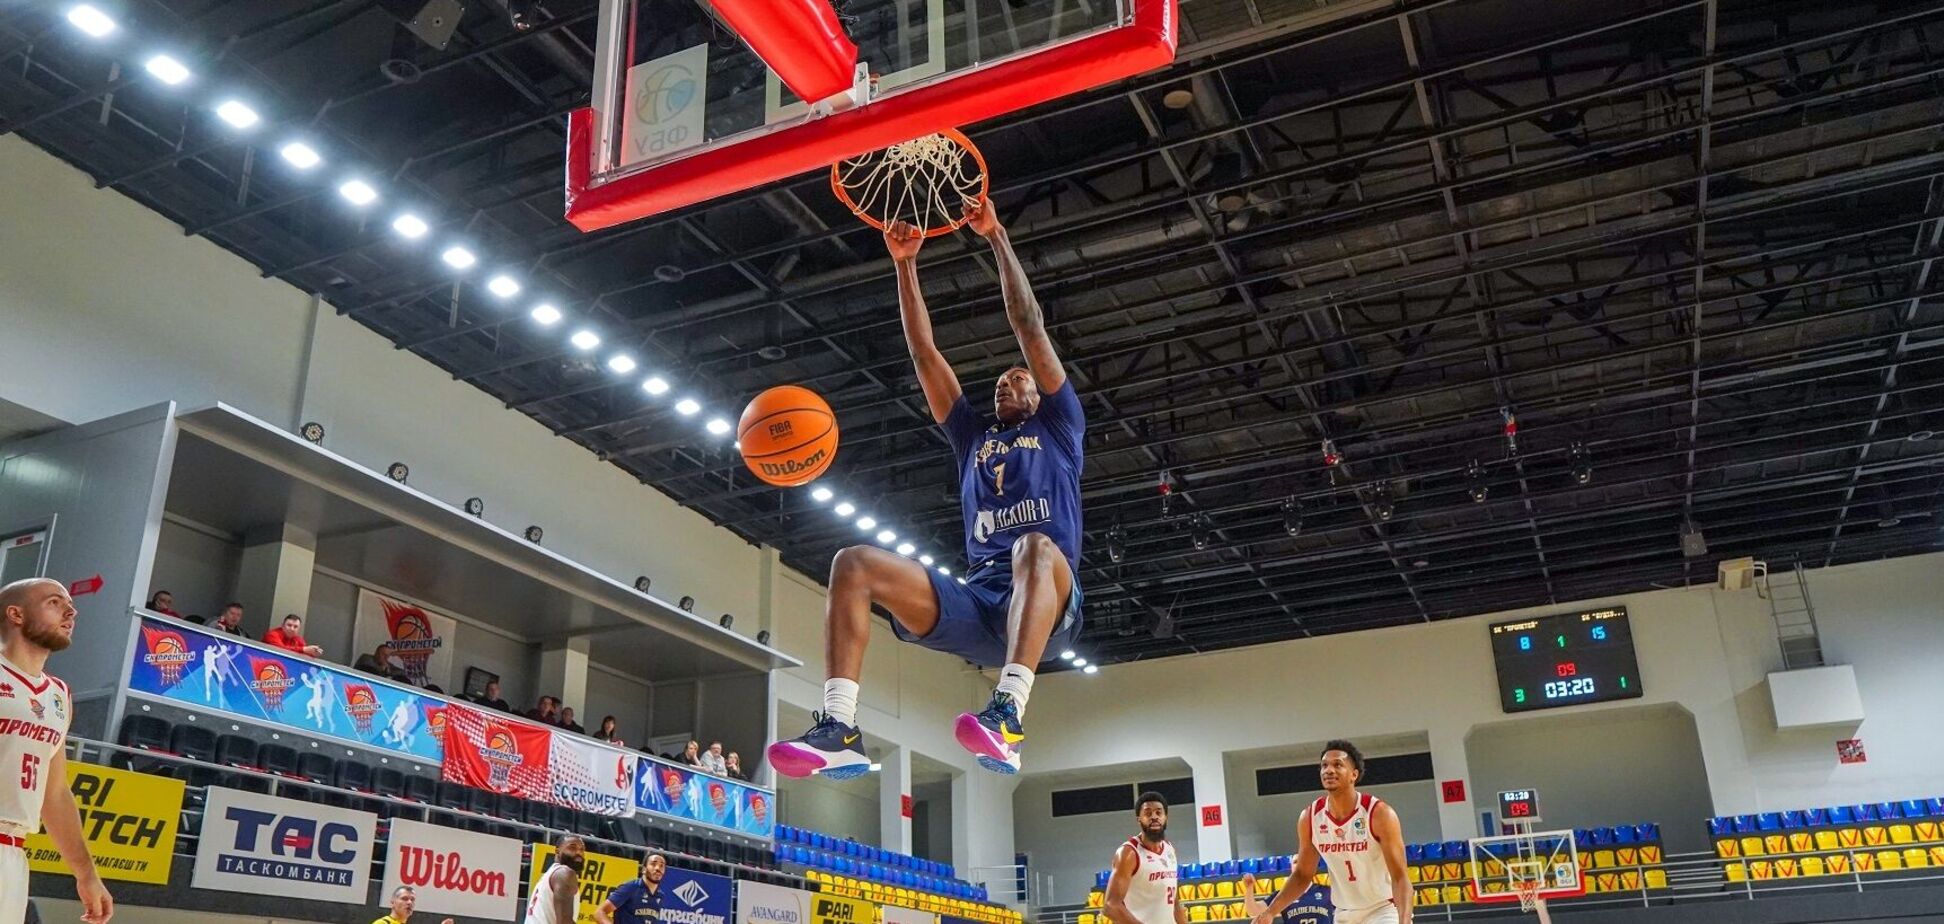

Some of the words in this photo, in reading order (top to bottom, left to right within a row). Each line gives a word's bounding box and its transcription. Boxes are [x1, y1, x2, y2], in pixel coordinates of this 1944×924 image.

[768, 420, 792, 436] FIBA
[759, 449, 825, 476] Wilson
[1592, 626, 1606, 640] 15
[1520, 636, 1531, 650] 8
[1557, 635, 1565, 648] 1
[1557, 663, 1576, 677] 09
[1545, 678, 1595, 698] 03:20
[1620, 676, 1626, 688] 1
[1514, 688, 1525, 702] 3
[71, 773, 115, 807] RI
[554, 783, 569, 800] SC
[1205, 810, 1220, 822] A6
[1511, 802, 1530, 816] 09
[225, 806, 358, 865] ТАС
[1319, 839, 1368, 854] ПРОМЕТЕЙ
[92, 855, 135, 871] МАГАЄШ
[135, 860, 149, 871] ТИ
[225, 858, 348, 884] ТАСКОМБАНК
[400, 845, 506, 897] Wilson
[1345, 860, 1357, 881] 1
[751, 905, 798, 923] AVANGARD
[816, 899, 854, 921] PARI
